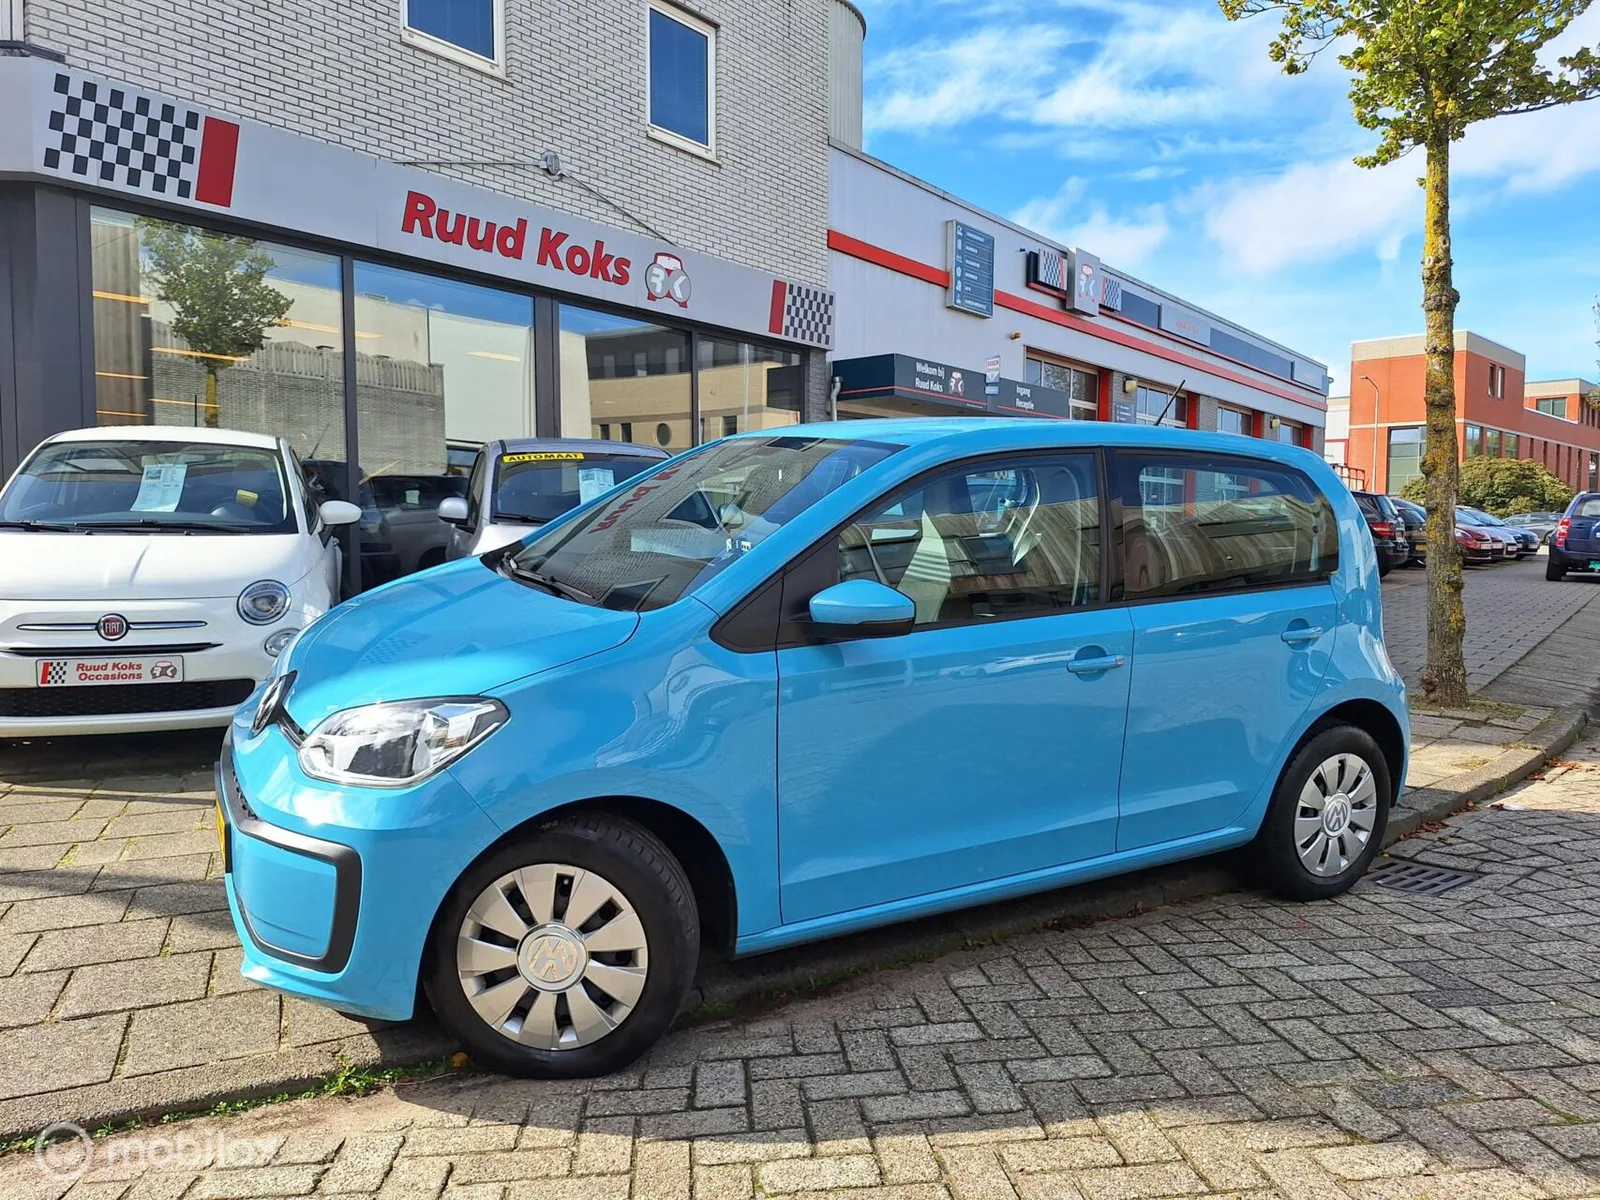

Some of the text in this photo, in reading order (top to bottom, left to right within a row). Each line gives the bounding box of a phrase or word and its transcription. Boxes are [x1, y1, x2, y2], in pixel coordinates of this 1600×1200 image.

[402, 190, 631, 286] Ruud Koks
[916, 361, 938, 376] Welkom
[915, 377, 943, 393] Ruud Koks
[508, 453, 581, 462] AUTOMAAT
[105, 622, 121, 633] FIAT
[76, 661, 143, 672] Ruud Koks
[78, 671, 143, 682] Occasions
